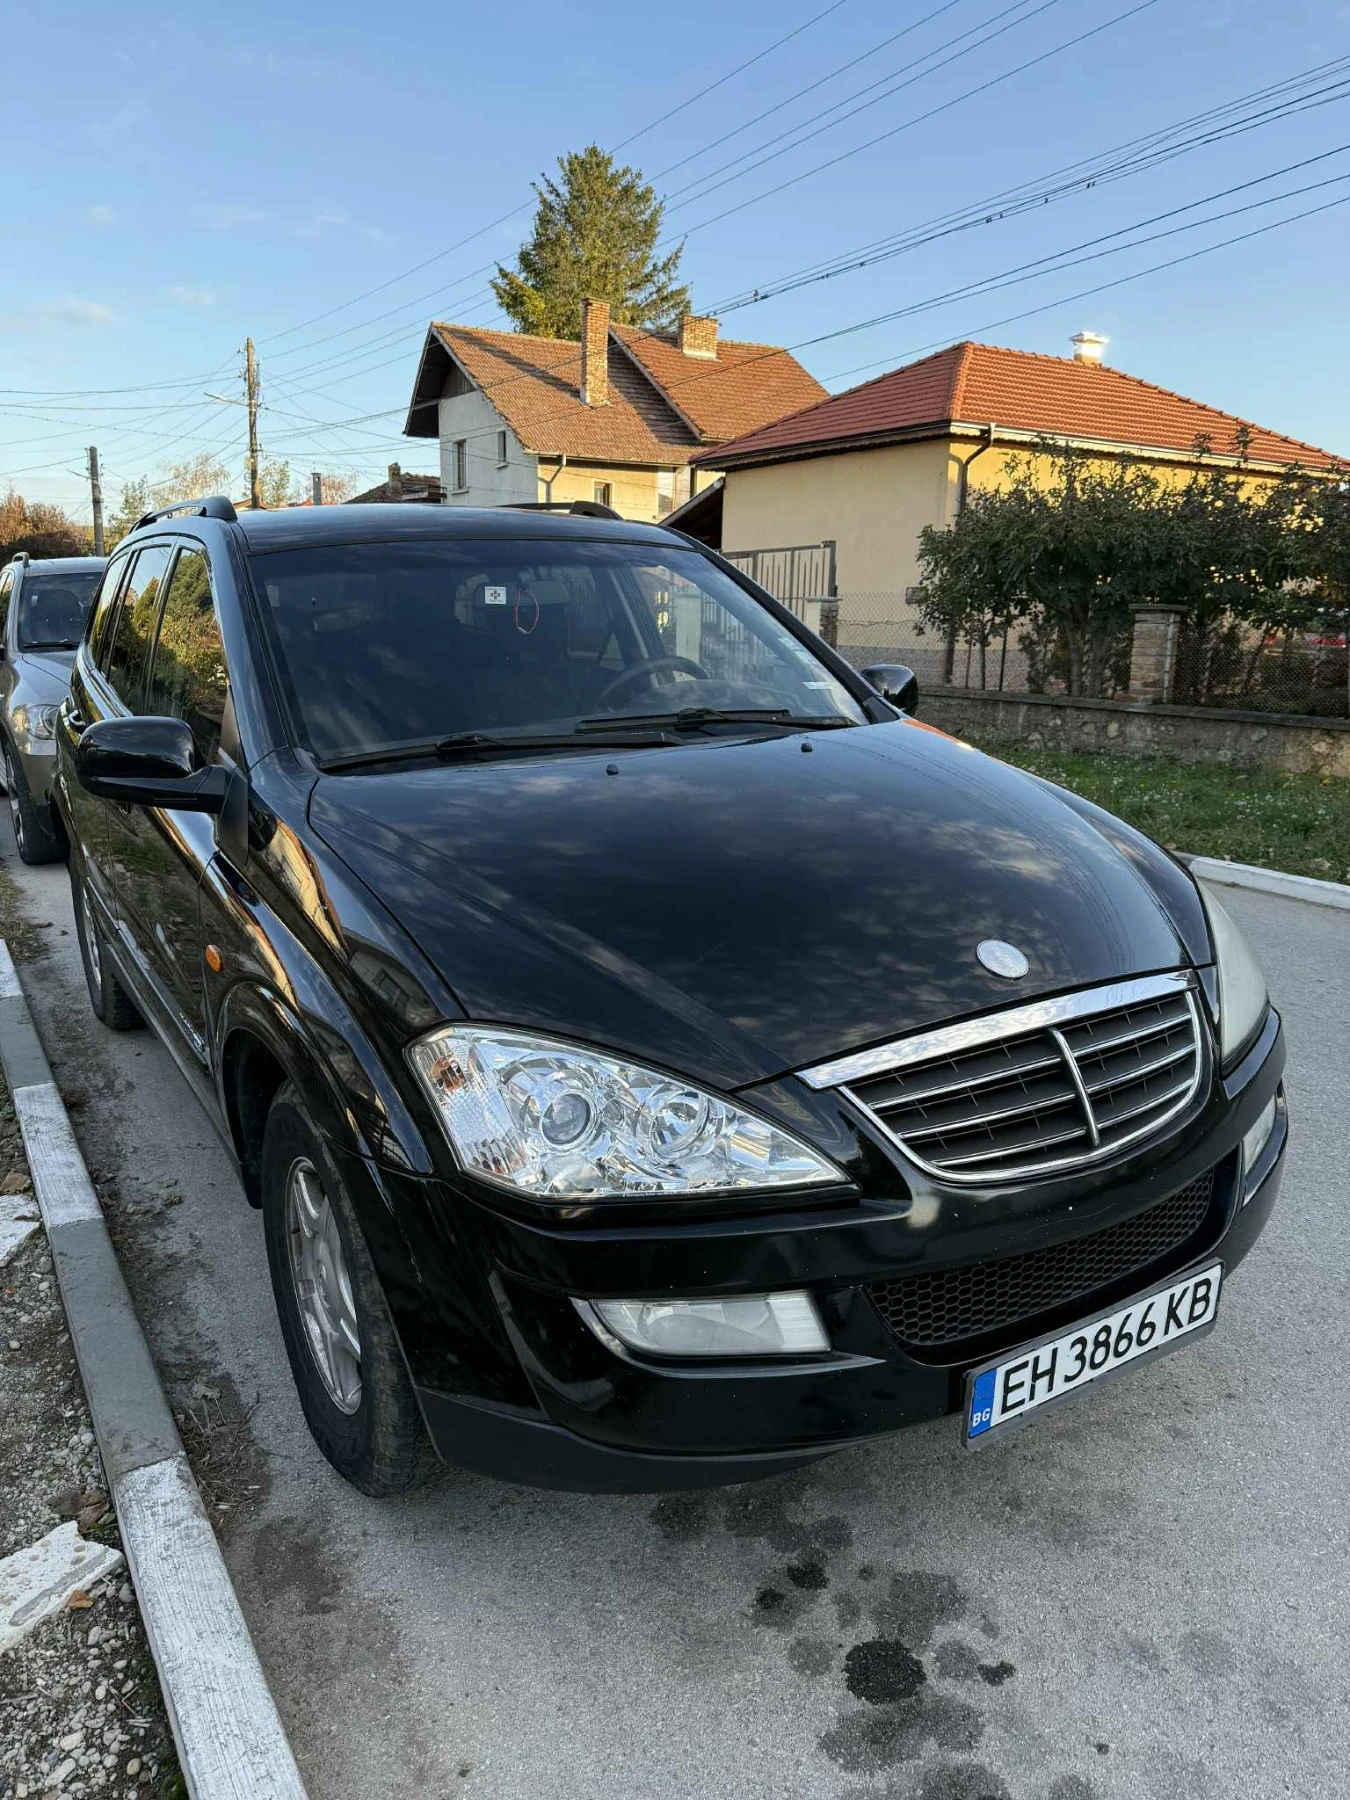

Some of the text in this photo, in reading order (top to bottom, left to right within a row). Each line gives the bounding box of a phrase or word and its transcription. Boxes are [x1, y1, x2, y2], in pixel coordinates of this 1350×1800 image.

[1000, 1277, 1213, 1415] EH 3866 KB
[972, 1407, 991, 1428] BG
